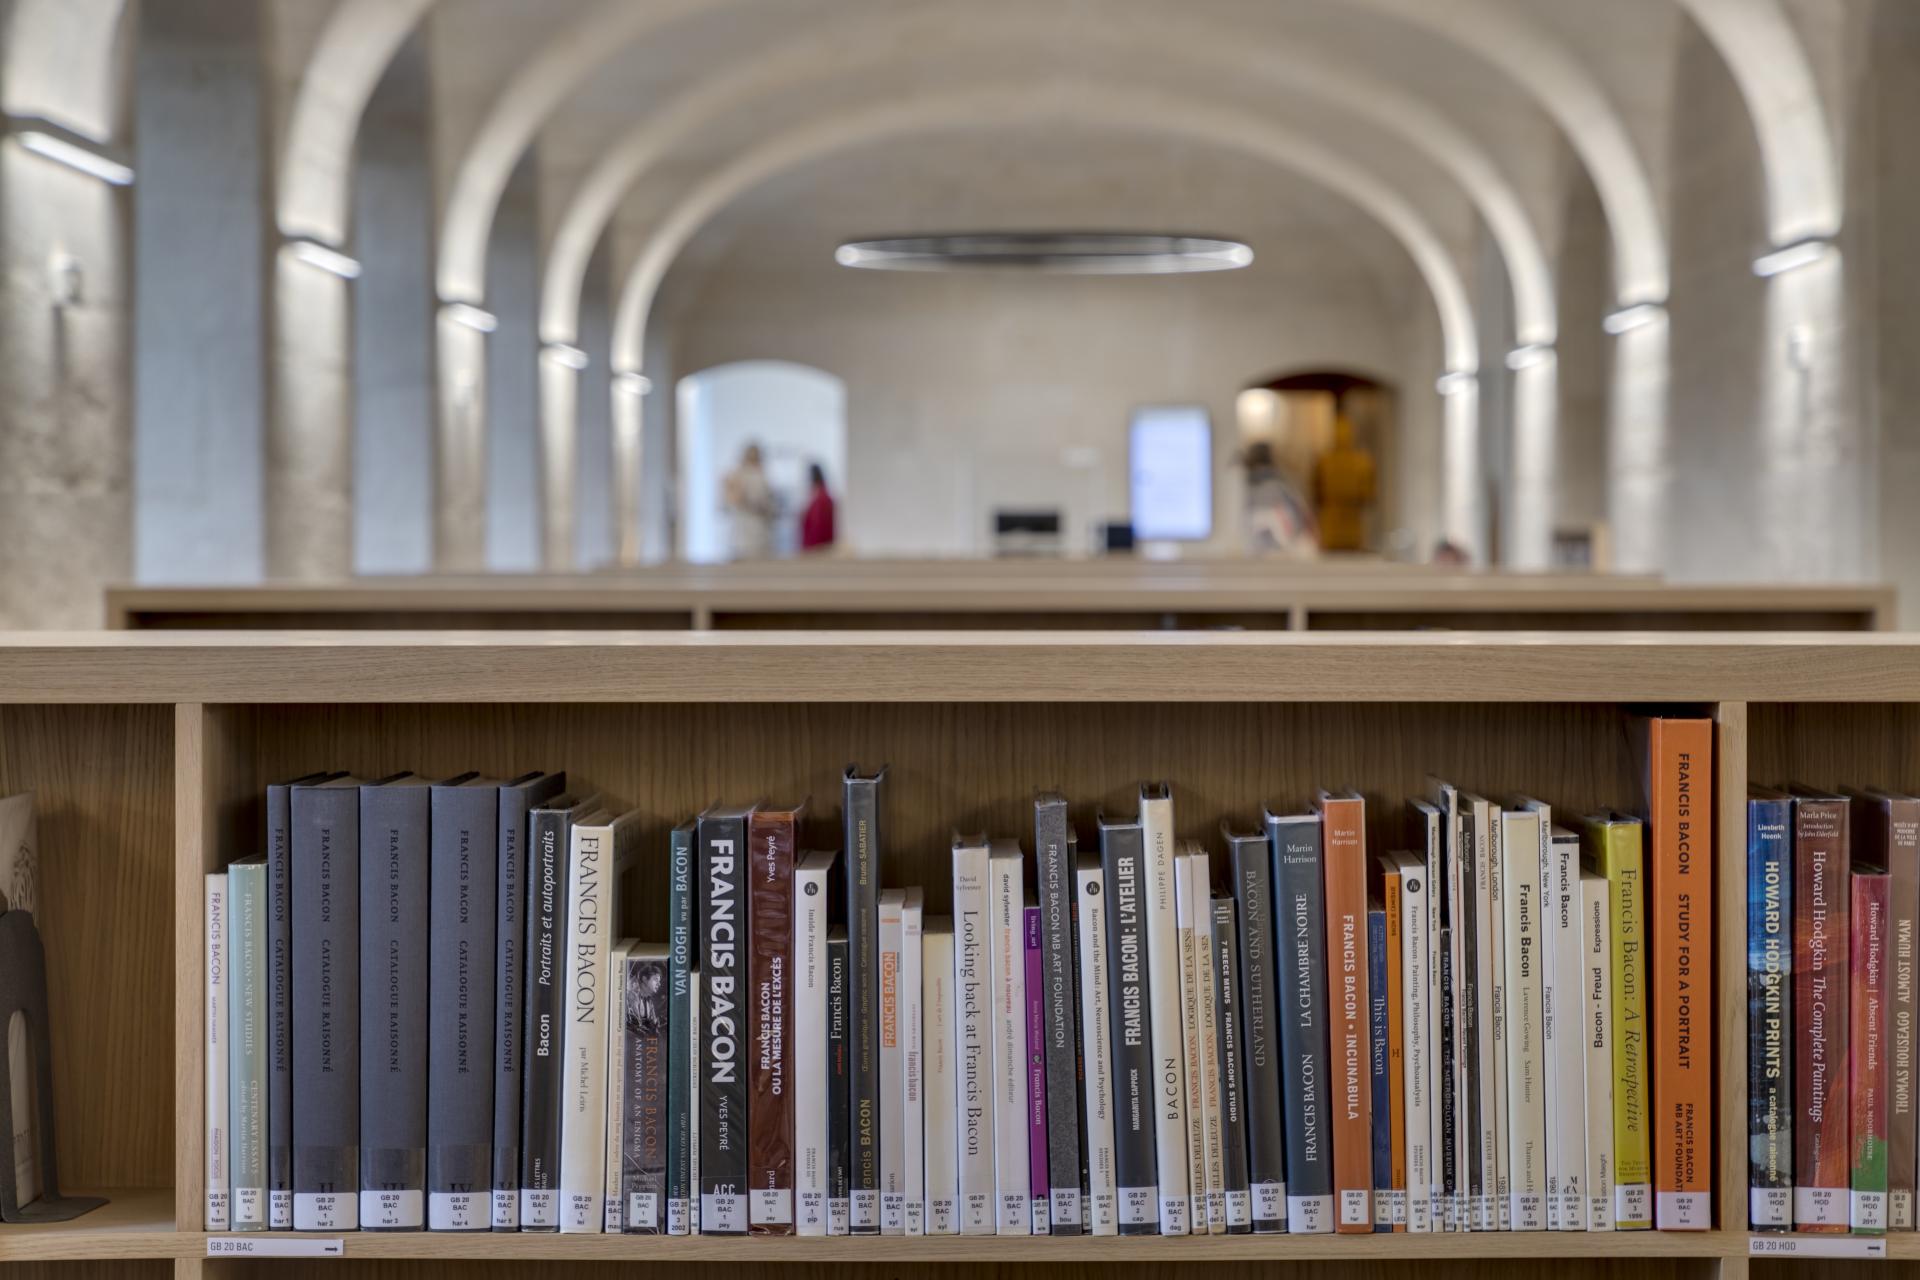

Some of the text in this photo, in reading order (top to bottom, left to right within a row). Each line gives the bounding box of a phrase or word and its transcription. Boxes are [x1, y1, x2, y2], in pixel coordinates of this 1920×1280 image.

[766, 836, 776, 883] Yves Peyré
[1284, 855, 1317, 863] Harrison
[1286, 844, 1313, 852] Martin
[1491, 819, 1499, 869] Marlborough,
[538, 831, 556, 985] Portraits et autoportraits
[675, 846, 688, 996] VAN GOGH vu par BACON
[1118, 857, 1136, 924] L'ATELIER
[1560, 853, 1570, 928] Francis Bacon
[1678, 753, 1690, 1069] FRANCIS BACON STUDY FOR A PORTRAIT
[1765, 861, 1779, 933] HOWARD
[211, 892, 221, 985] FRANCIS BACON
[321, 828, 333, 1072] FRANCIS BACON CATALOGUE RAISONNÉ
[576, 837, 599, 1024] FRANCIS BACON
[710, 839, 735, 1082] FRANCIS BACON
[1048, 844, 1064, 1048] FRANCIS BACON MB ART FOUNDATION
[1092, 934, 1100, 948] and
[1520, 884, 1532, 977] Francis Bacon
[244, 893, 253, 1055] FRANCIS BACON NEW STUDIES
[831, 958, 842, 994] Bacon
[1093, 990, 1102, 1005] Art,
[1223, 978, 1231, 1004] MEWS
[1246, 870, 1265, 1066] BACON AND SUTHERLAND
[1593, 901, 1604, 1048] Bacon Freud Expressions
[1765, 939, 1780, 1013] HODGKIN
[1808, 851, 1827, 1123] Howard Hodgkin The Complete Paintings
[1868, 902, 1879, 1070] Howard Hodgkin Absent Friends
[760, 982, 770, 1069] FRANCIS BACON
[771, 957, 782, 1095] OU LA MESURE DE L'EXCÈS
[830, 996, 842, 1039] Francis
[1124, 987, 1141, 1046] FRANCIS
[1225, 1012, 1233, 1049] FRANCIS
[1296, 894, 1317, 1161] FRANCIS BACON LA CHAMBRE NOIRE
[1343, 915, 1360, 1120] FRANCIS BACON INCUNABULA
[1374, 995, 1386, 1023] This
[1374, 1025, 1386, 1035] is
[1621, 868, 1642, 1132] Francis Bacon: A Retrospective
[1895, 919, 1911, 1114] THOMAS HOUSEAGO ALMOST HUMAN
[537, 1014, 550, 1056] Bacon
[960, 911, 983, 1155] Looking back at Francis Bacon
[1096, 1007, 1104, 1058] Neuroscience
[1374, 1038, 1387, 1075] Bacon
[1766, 1018, 1780, 1078] PRINTS
[645, 1036, 658, 1158] FRANCIS BACON
[1097, 1060, 1105, 1075] and
[1165, 1058, 1179, 1120] BACON
[1227, 1051, 1235, 1089] BACON'S
[634, 1038, 642, 1159] ANATOMY OF AN ENIGMA
[719, 1095, 730, 1150] YVES PEYRÉ
[861, 1099, 871, 1145] BACON
[1096, 1077, 1106, 1120] Psychology
[1229, 1090, 1237, 1122] STUDIO
[1769, 1095, 1779, 1140] catalogue
[713, 1184, 736, 1195] ACC
[1769, 1142, 1779, 1182] raisonné
[210, 1242, 253, 1251] GB 20 BAC
[1752, 1241, 1796, 1251] GB 20 HOD
